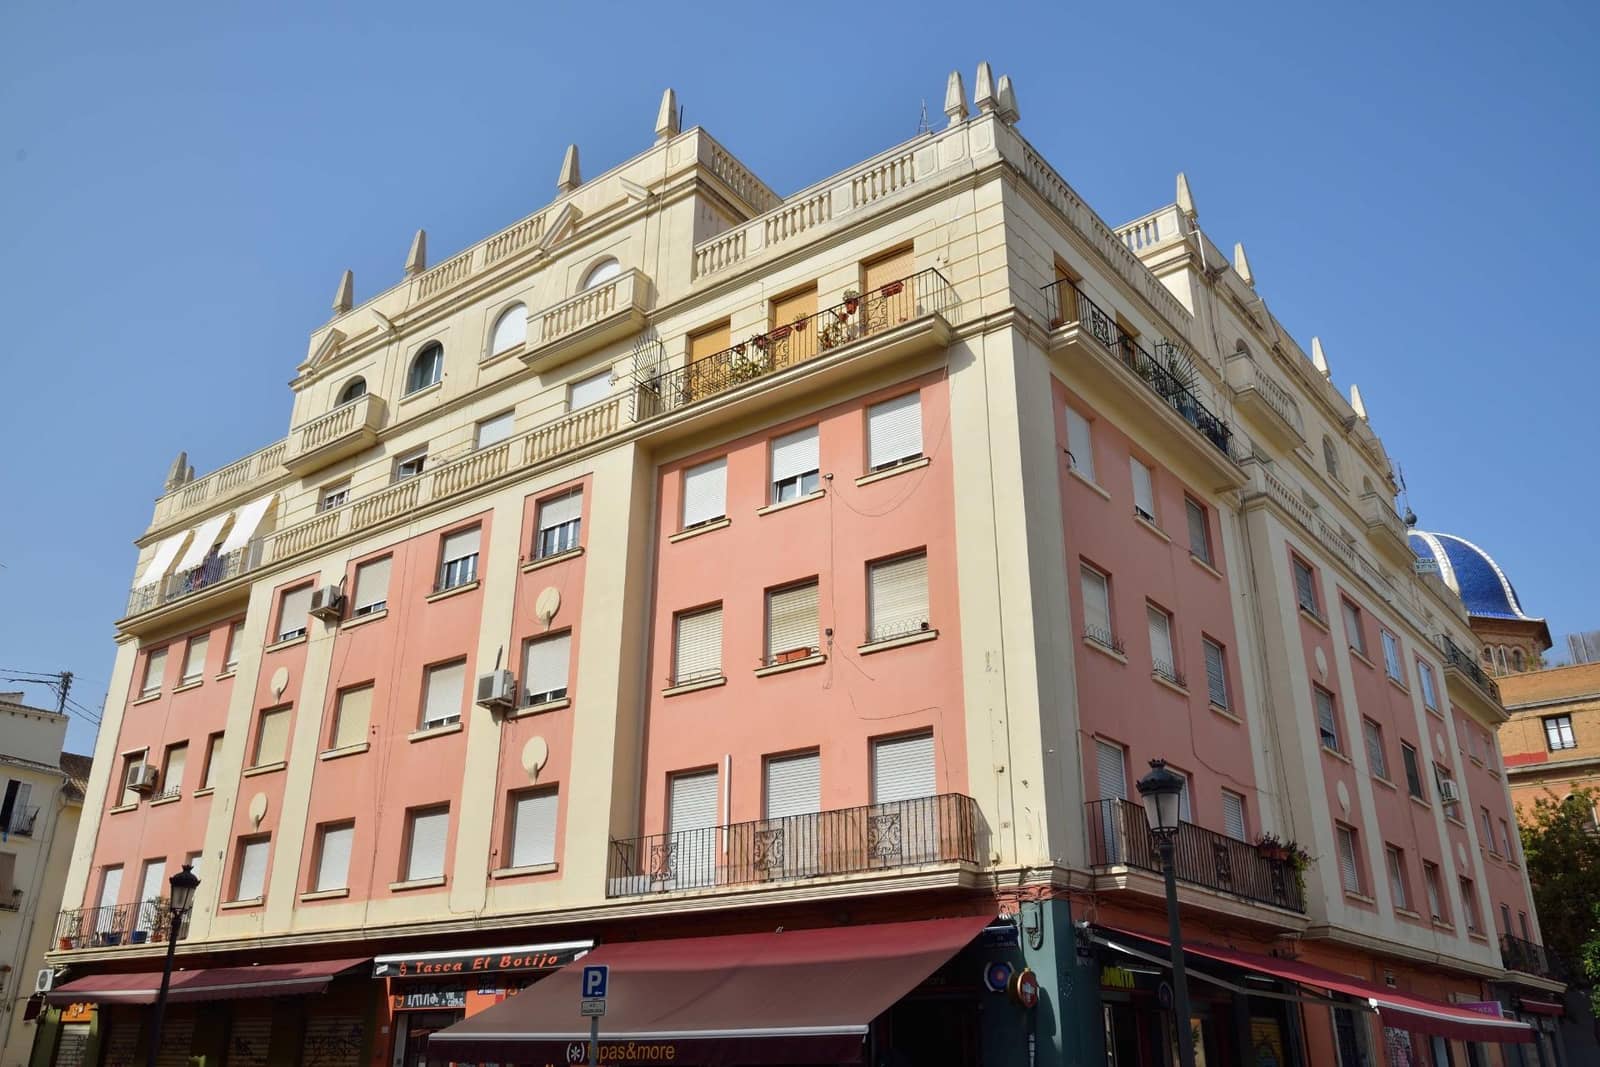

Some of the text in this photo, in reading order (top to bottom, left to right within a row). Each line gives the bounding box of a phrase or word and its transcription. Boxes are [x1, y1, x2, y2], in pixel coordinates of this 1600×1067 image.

[415, 953, 558, 974] Tasca El Botijo
[587, 970, 602, 995] P
[587, 1041, 675, 1063] tpas&more
